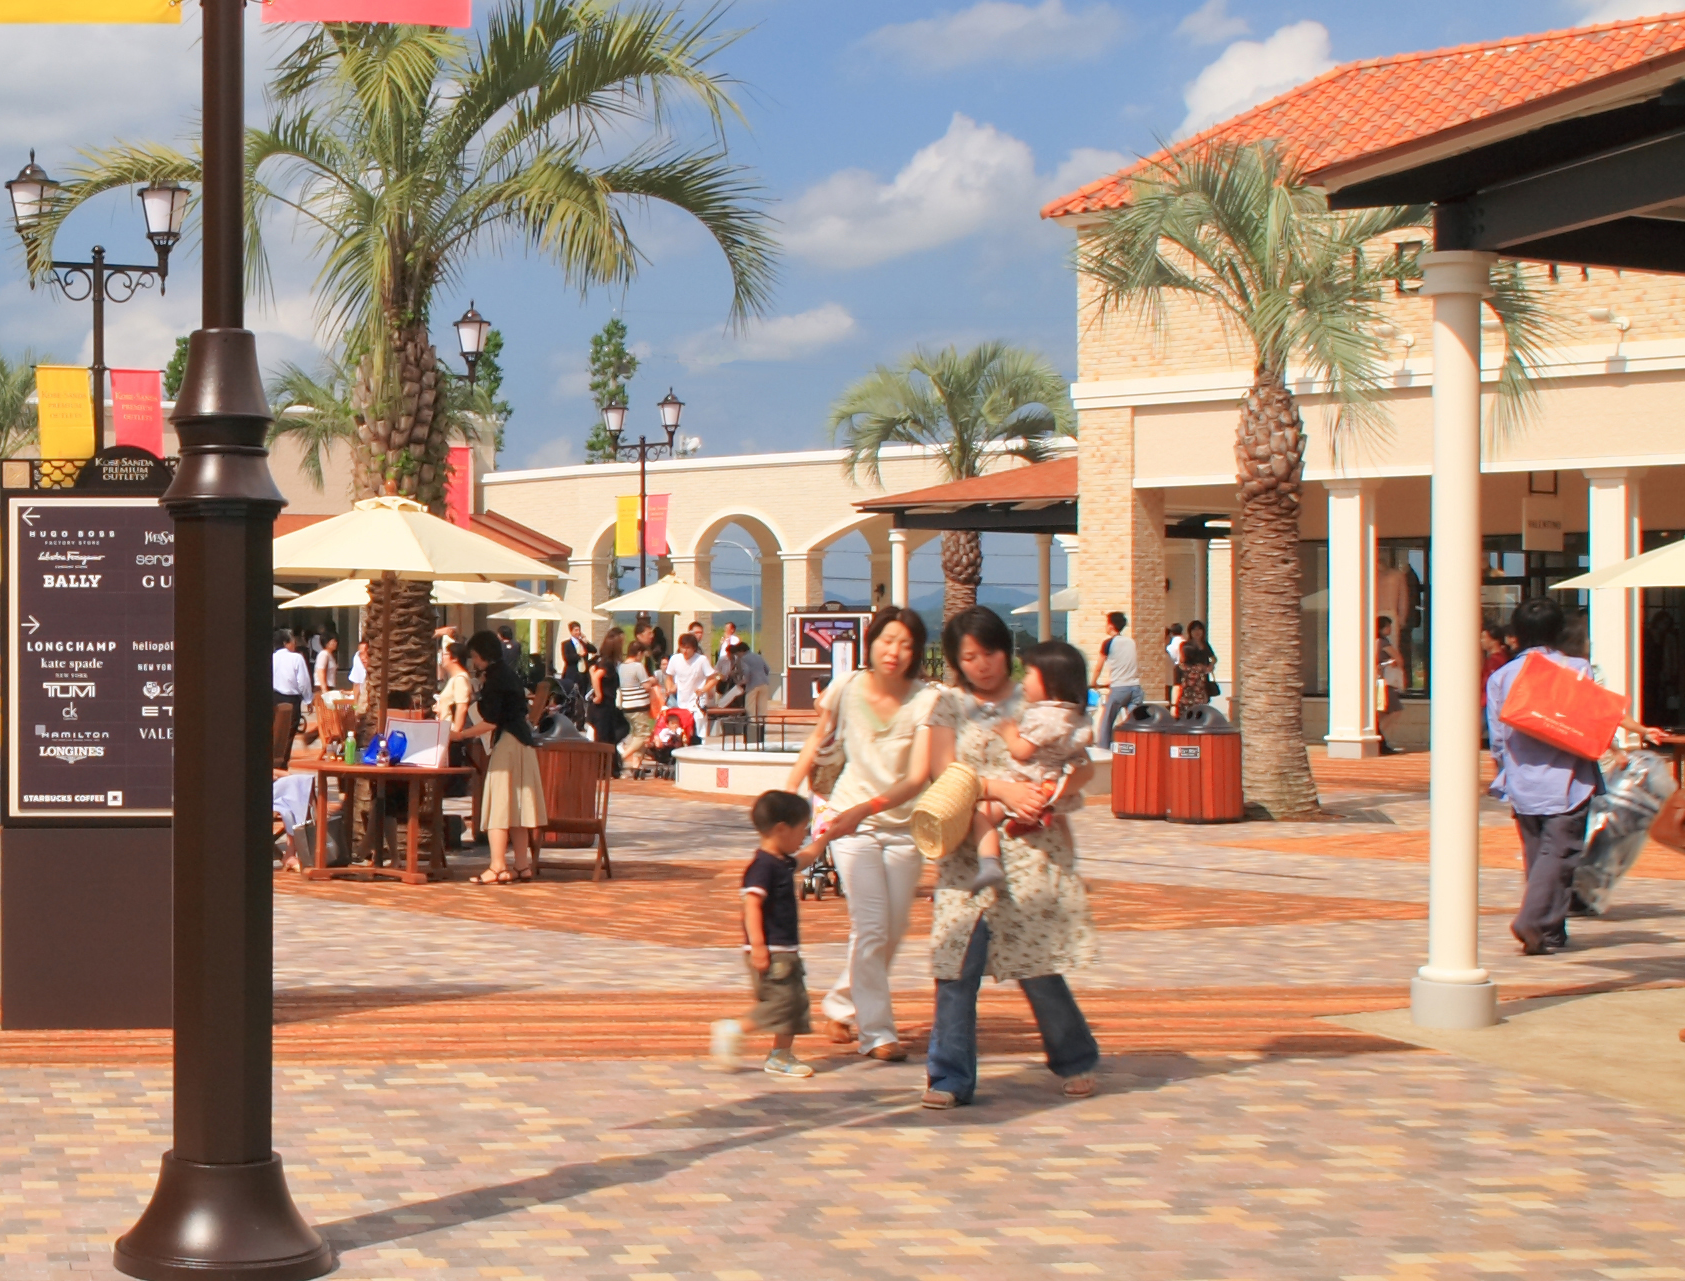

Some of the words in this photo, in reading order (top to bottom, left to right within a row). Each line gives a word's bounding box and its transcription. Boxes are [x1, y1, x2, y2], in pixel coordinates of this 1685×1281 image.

[102, 466, 149, 474] PREMIUM
[29, 530, 68, 538] HUGO
[77, 530, 115, 538] BOSS
[135, 554, 174, 567] sergi
[43, 574, 102, 588] BALLY
[141, 575, 172, 588] GU
[26, 641, 117, 652] LONGCHAMP
[40, 657, 66, 669] kate
[69, 657, 104, 672] spade
[156, 663, 172, 672] YOR
[42, 682, 96, 698] TUMI
[141, 706, 174, 717] ET
[138, 727, 174, 740] VALE
[39, 746, 105, 757] LONGINES
[23, 794, 72, 803] STARBUCKS
[74, 794, 105, 803] COFFEE
